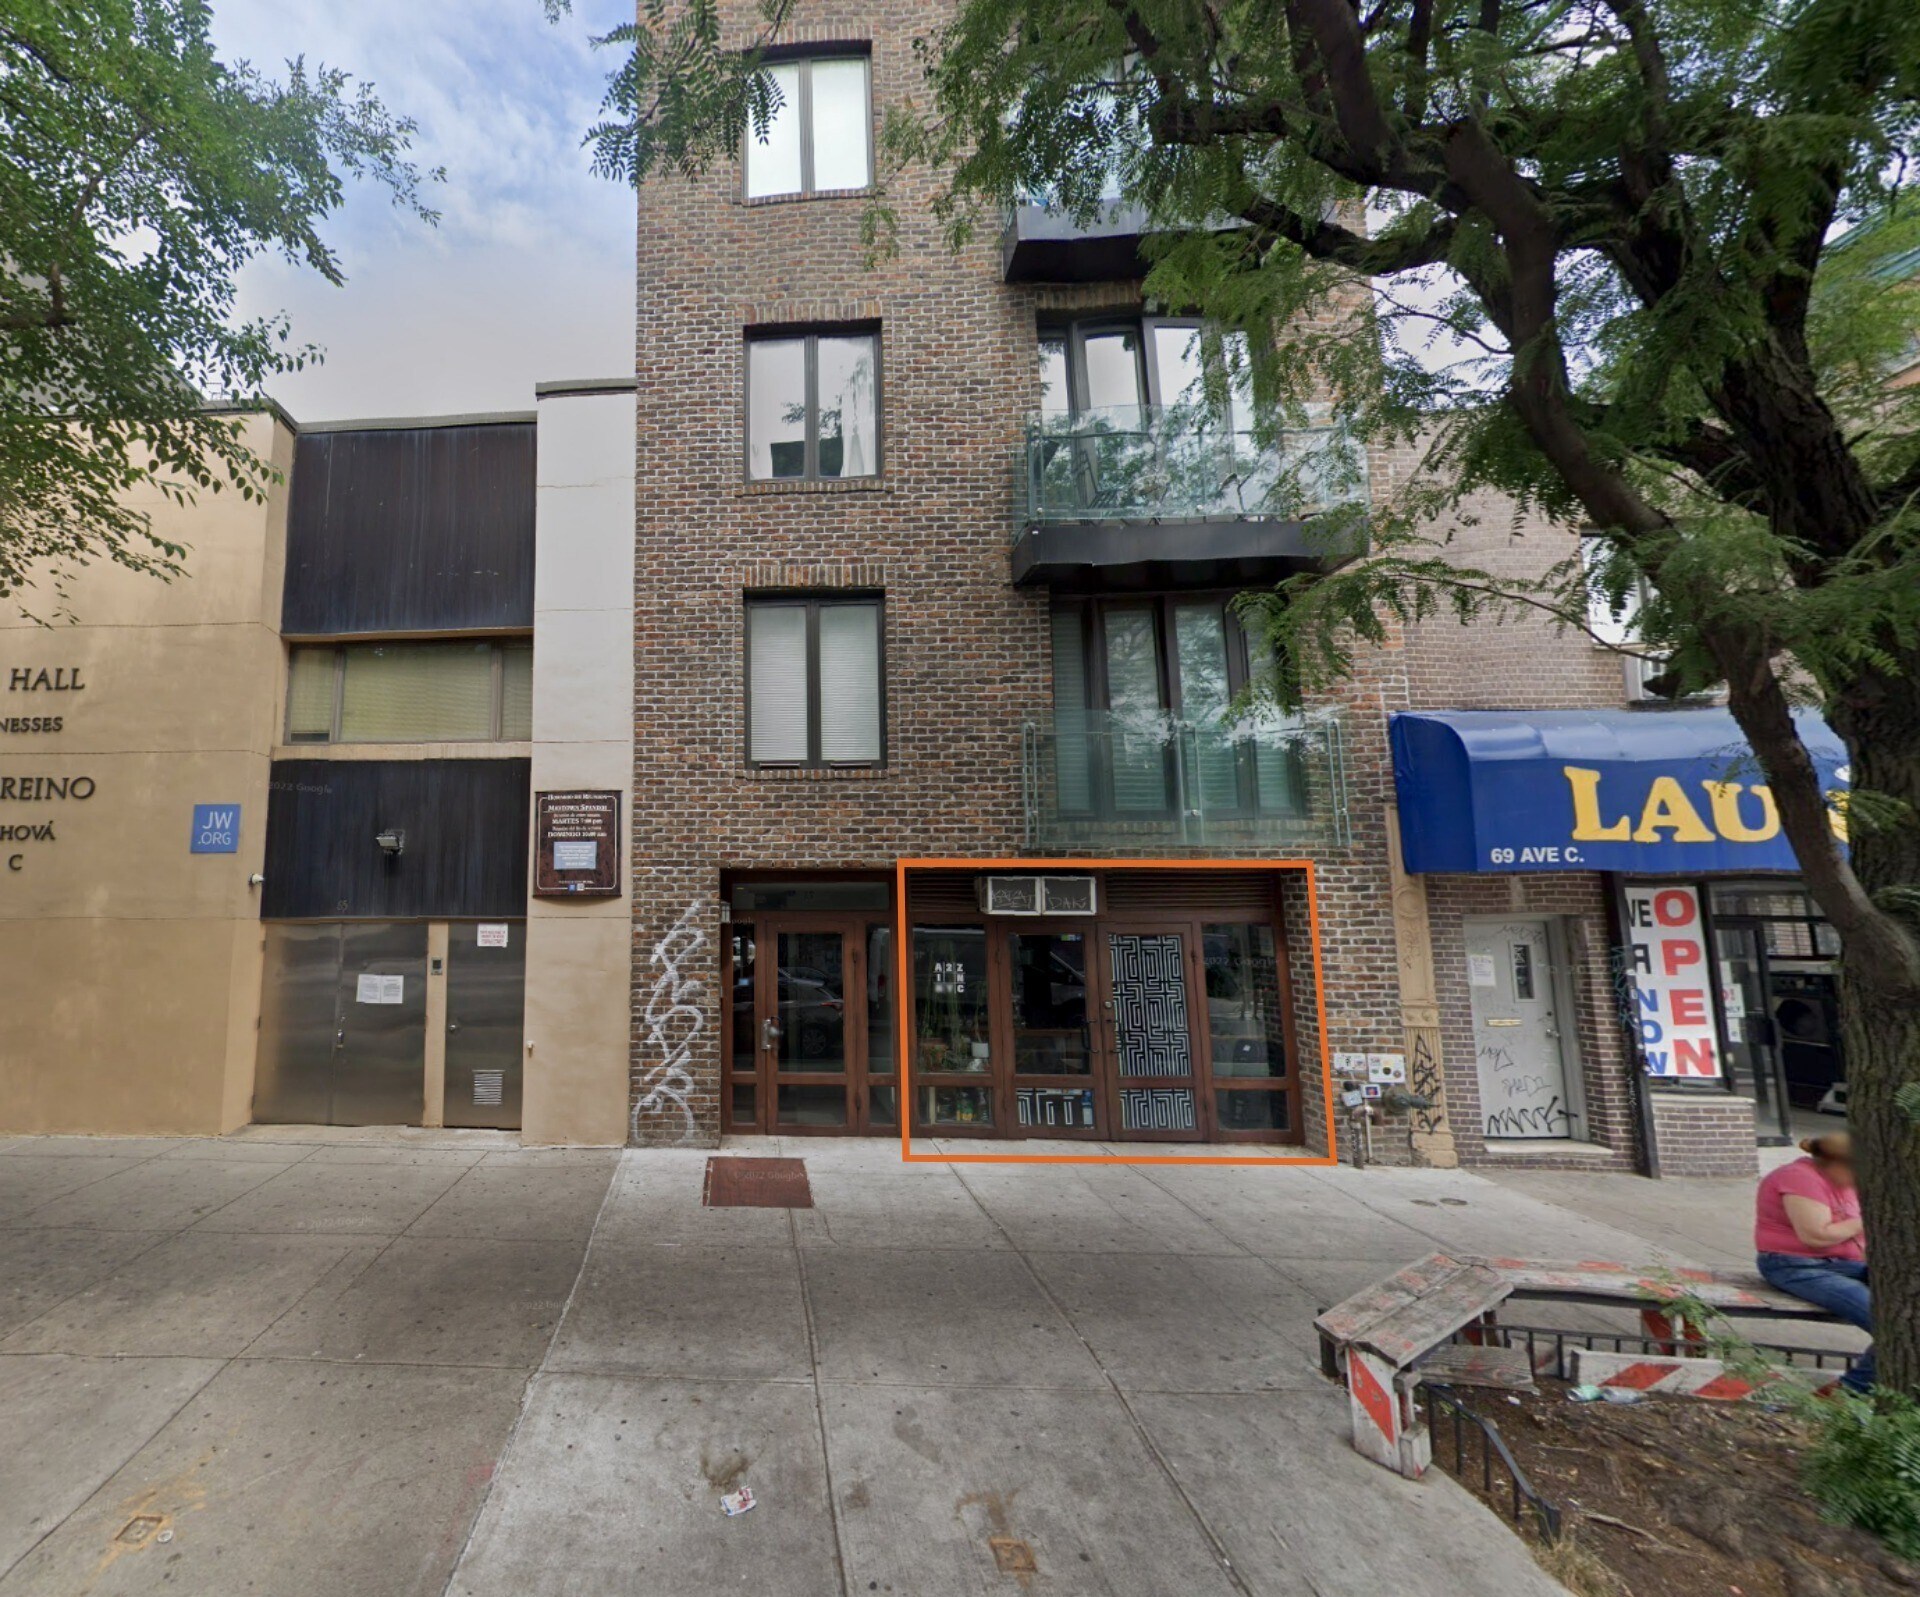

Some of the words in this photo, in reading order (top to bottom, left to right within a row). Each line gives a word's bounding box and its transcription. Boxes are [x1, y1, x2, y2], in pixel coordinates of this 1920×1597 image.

[9, 667, 85, 692] HALL
[0, 776, 96, 800] REINO
[1564, 766, 1849, 843] LAU
[0, 820, 56, 841] HOVÁ
[202, 811, 233, 830] JW
[198, 832, 232, 846] .ORG
[8, 854, 24, 871] C
[1491, 847, 1516, 864] 69
[1520, 846, 1560, 863] AVE
[1564, 846, 1585, 863] C.
[1654, 889, 1716, 1076] OPEN
